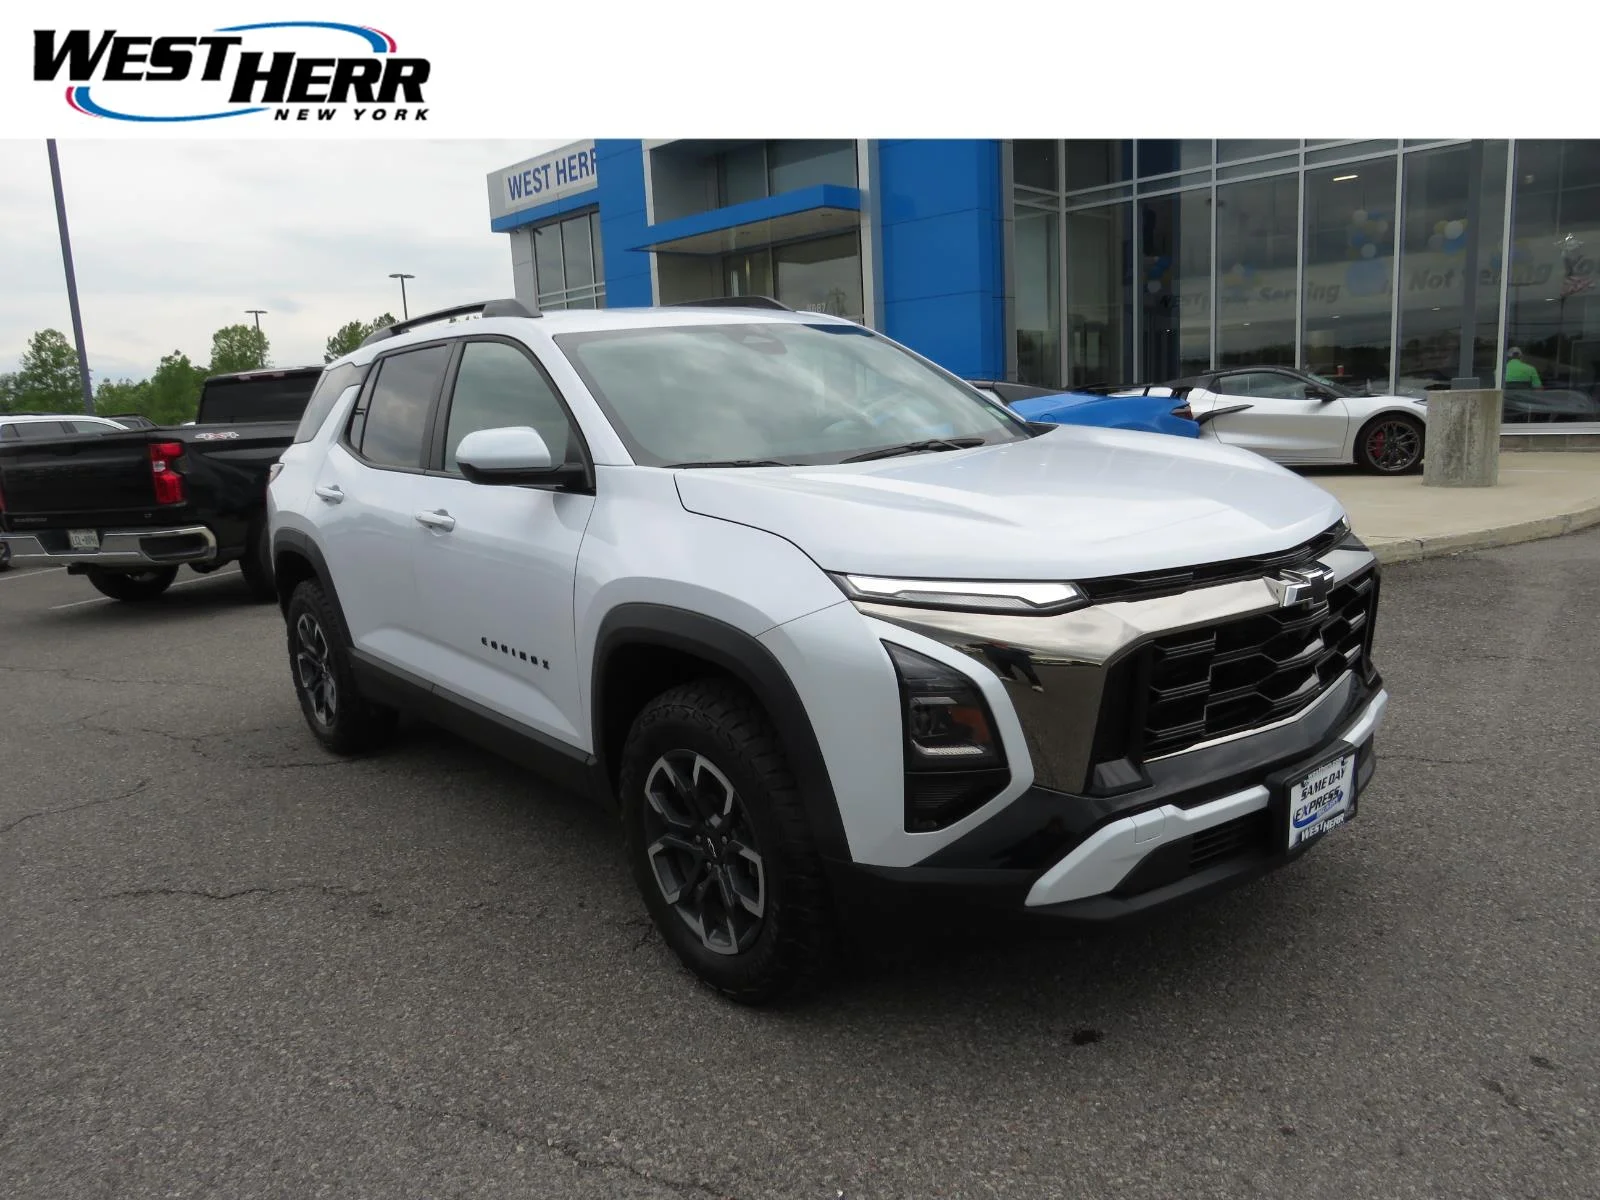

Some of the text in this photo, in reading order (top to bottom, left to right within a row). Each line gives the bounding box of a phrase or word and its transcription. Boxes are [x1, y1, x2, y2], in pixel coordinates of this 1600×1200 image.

[508, 163, 551, 201] WEST
[1258, 280, 1341, 304] Sering
[1300, 776, 1328, 801] SAME
[1328, 766, 1346, 786] DAY
[1295, 785, 1341, 821] EXPRESS
